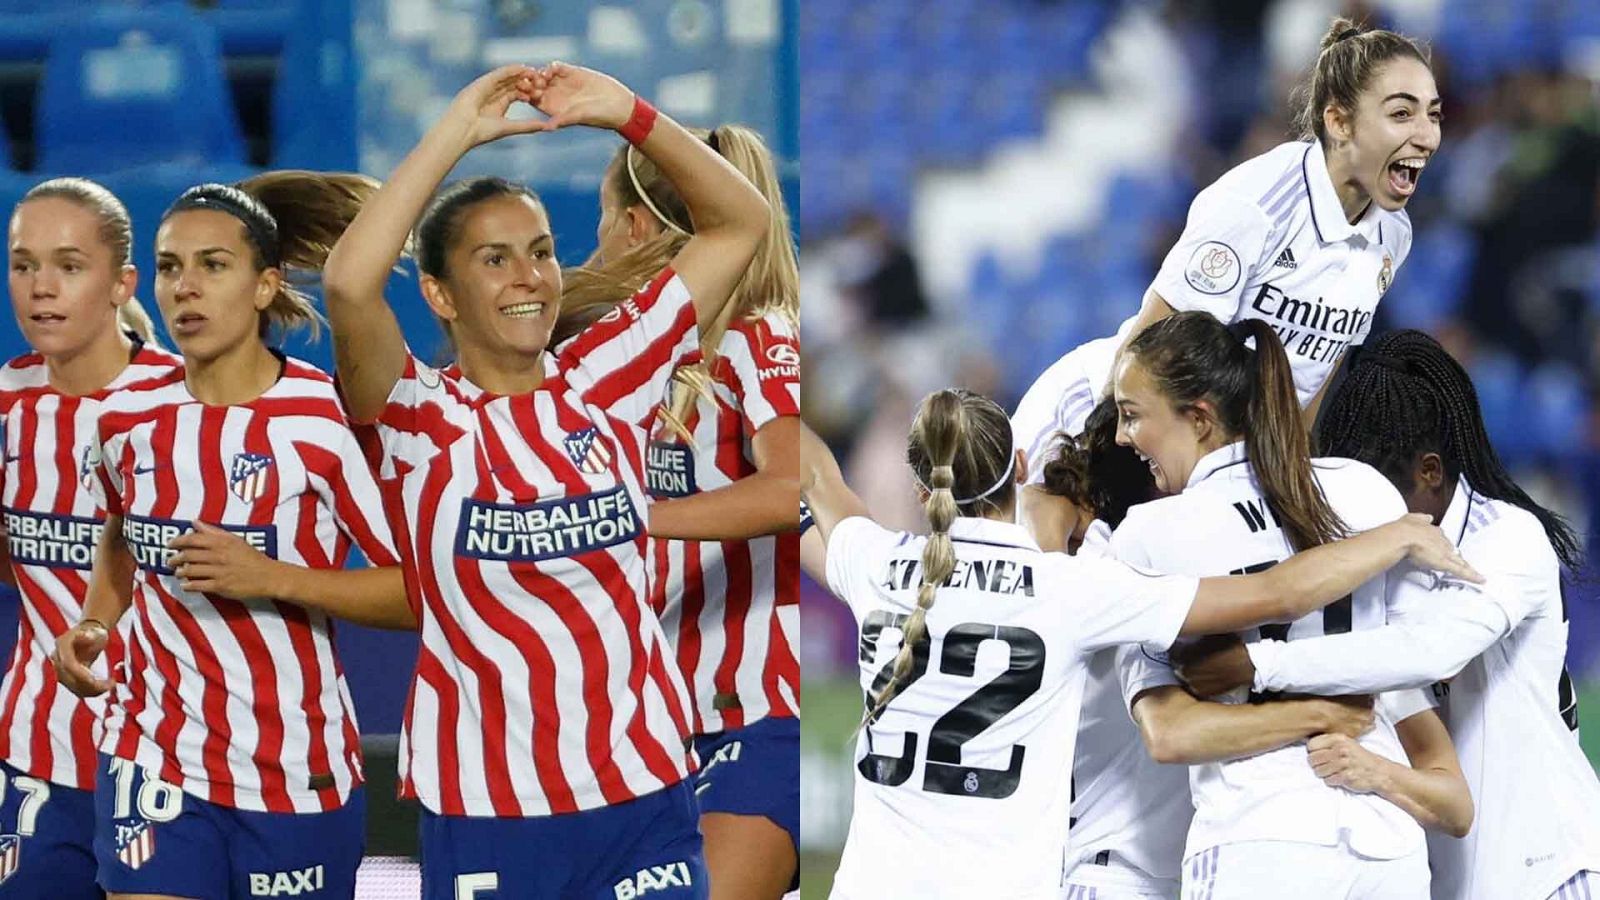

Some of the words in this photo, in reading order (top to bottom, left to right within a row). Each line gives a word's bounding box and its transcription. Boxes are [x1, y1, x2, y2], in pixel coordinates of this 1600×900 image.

[1252, 282, 1371, 336] Emirate
[466, 511, 635, 555] NUTRITION
[469, 490, 629, 533] HERBALIFE
[881, 559, 1035, 597] ATENEA
[858, 609, 1046, 799] 22
[108, 757, 183, 822] 18
[249, 864, 323, 896] BAXI
[614, 862, 692, 900] BAXI
